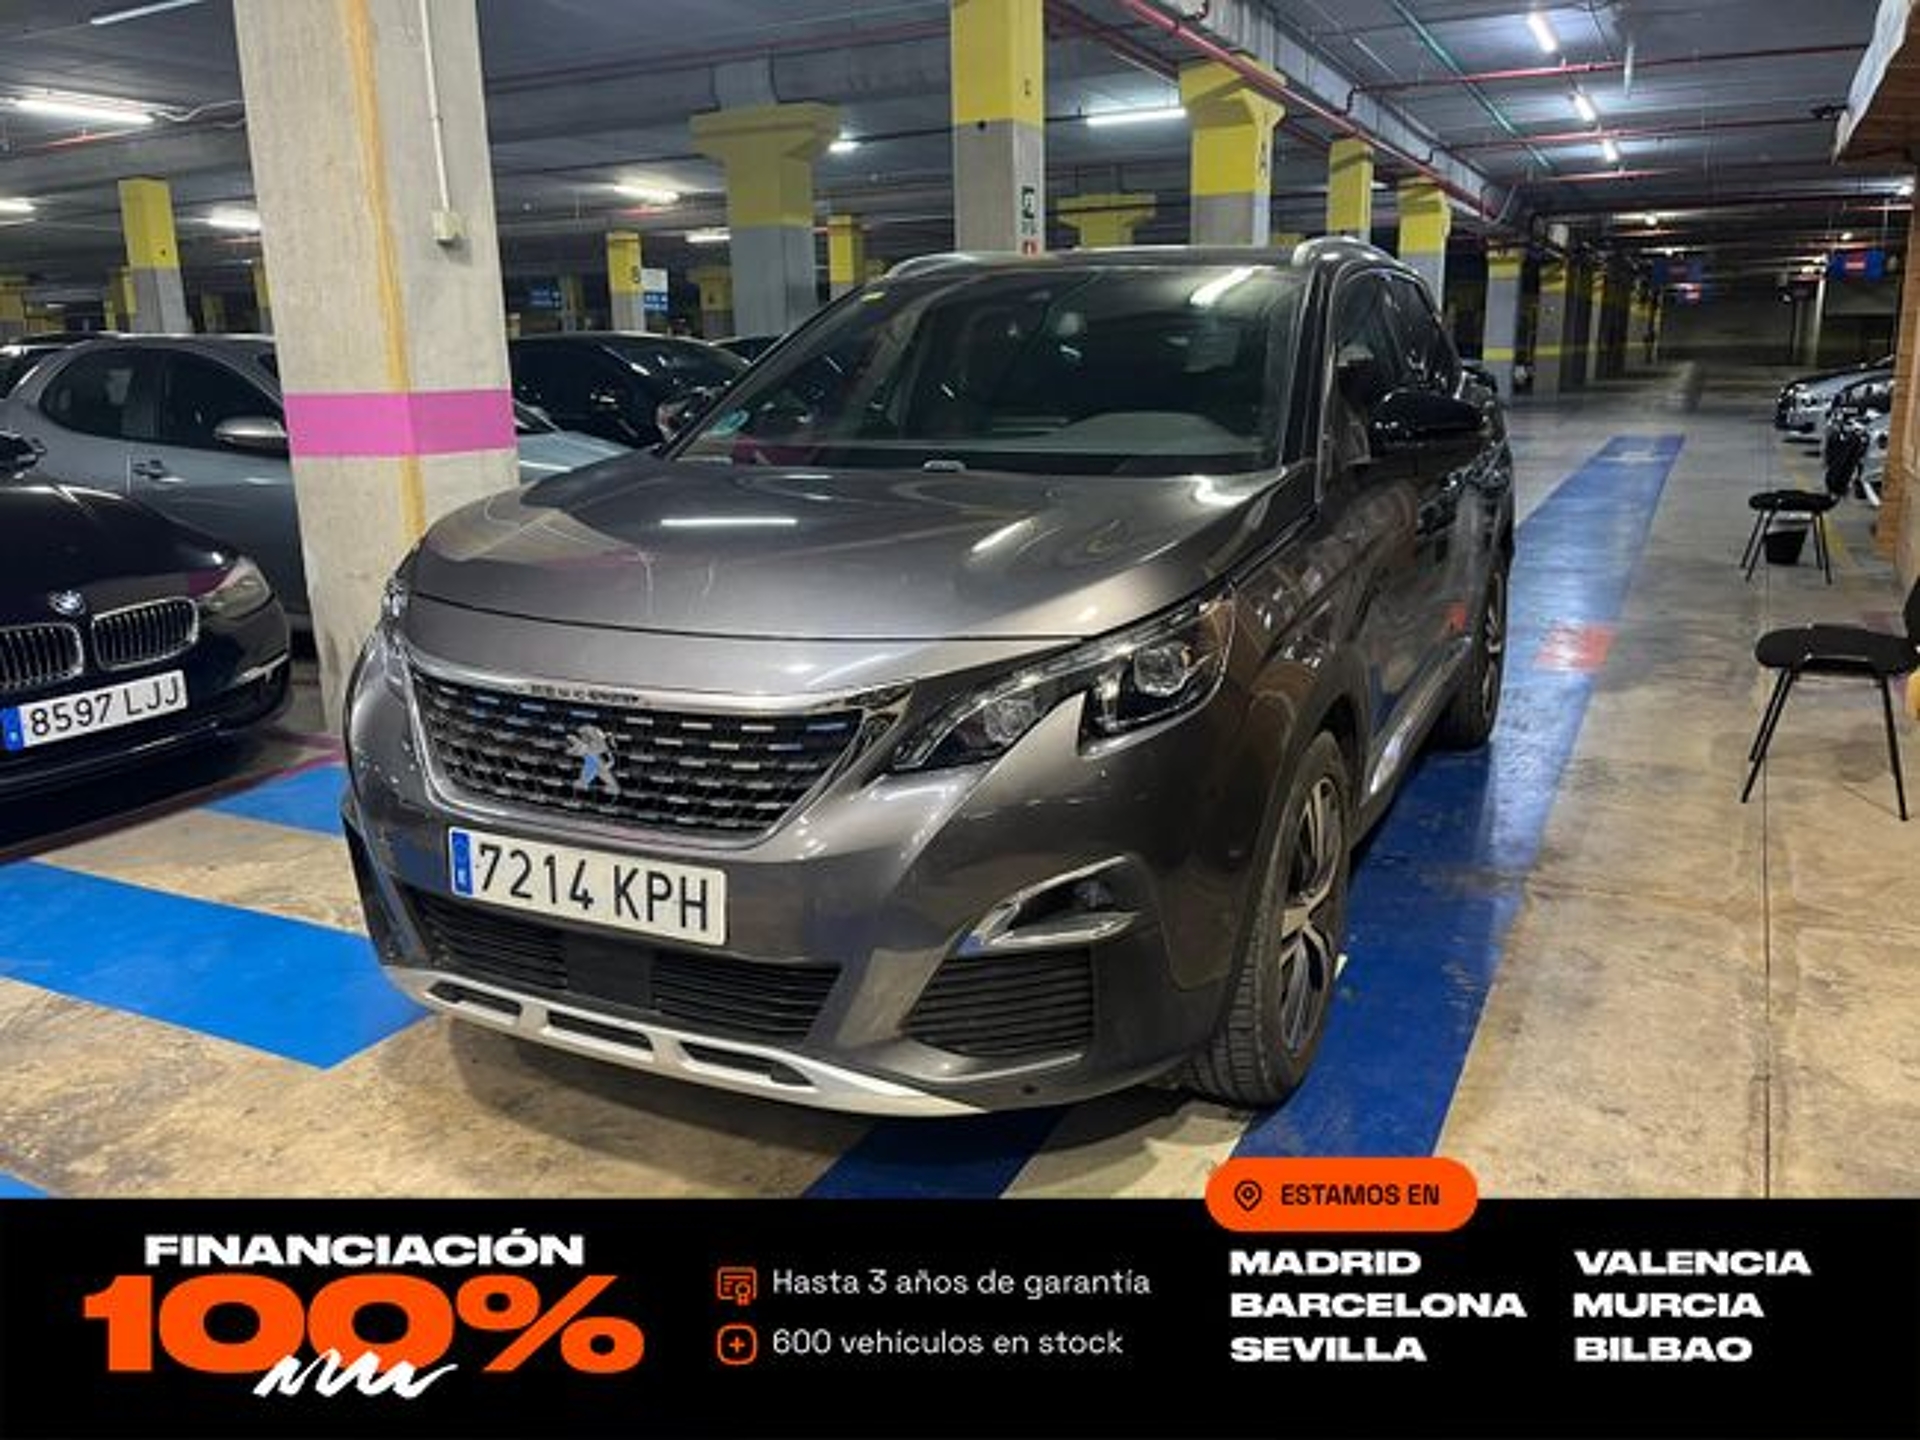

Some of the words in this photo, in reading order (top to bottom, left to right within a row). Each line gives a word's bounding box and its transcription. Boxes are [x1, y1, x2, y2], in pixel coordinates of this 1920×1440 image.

[30, 693, 113, 737] 8597
[123, 677, 180, 716] LJJ
[478, 843, 594, 910] 7214
[613, 865, 708, 932] KPH
